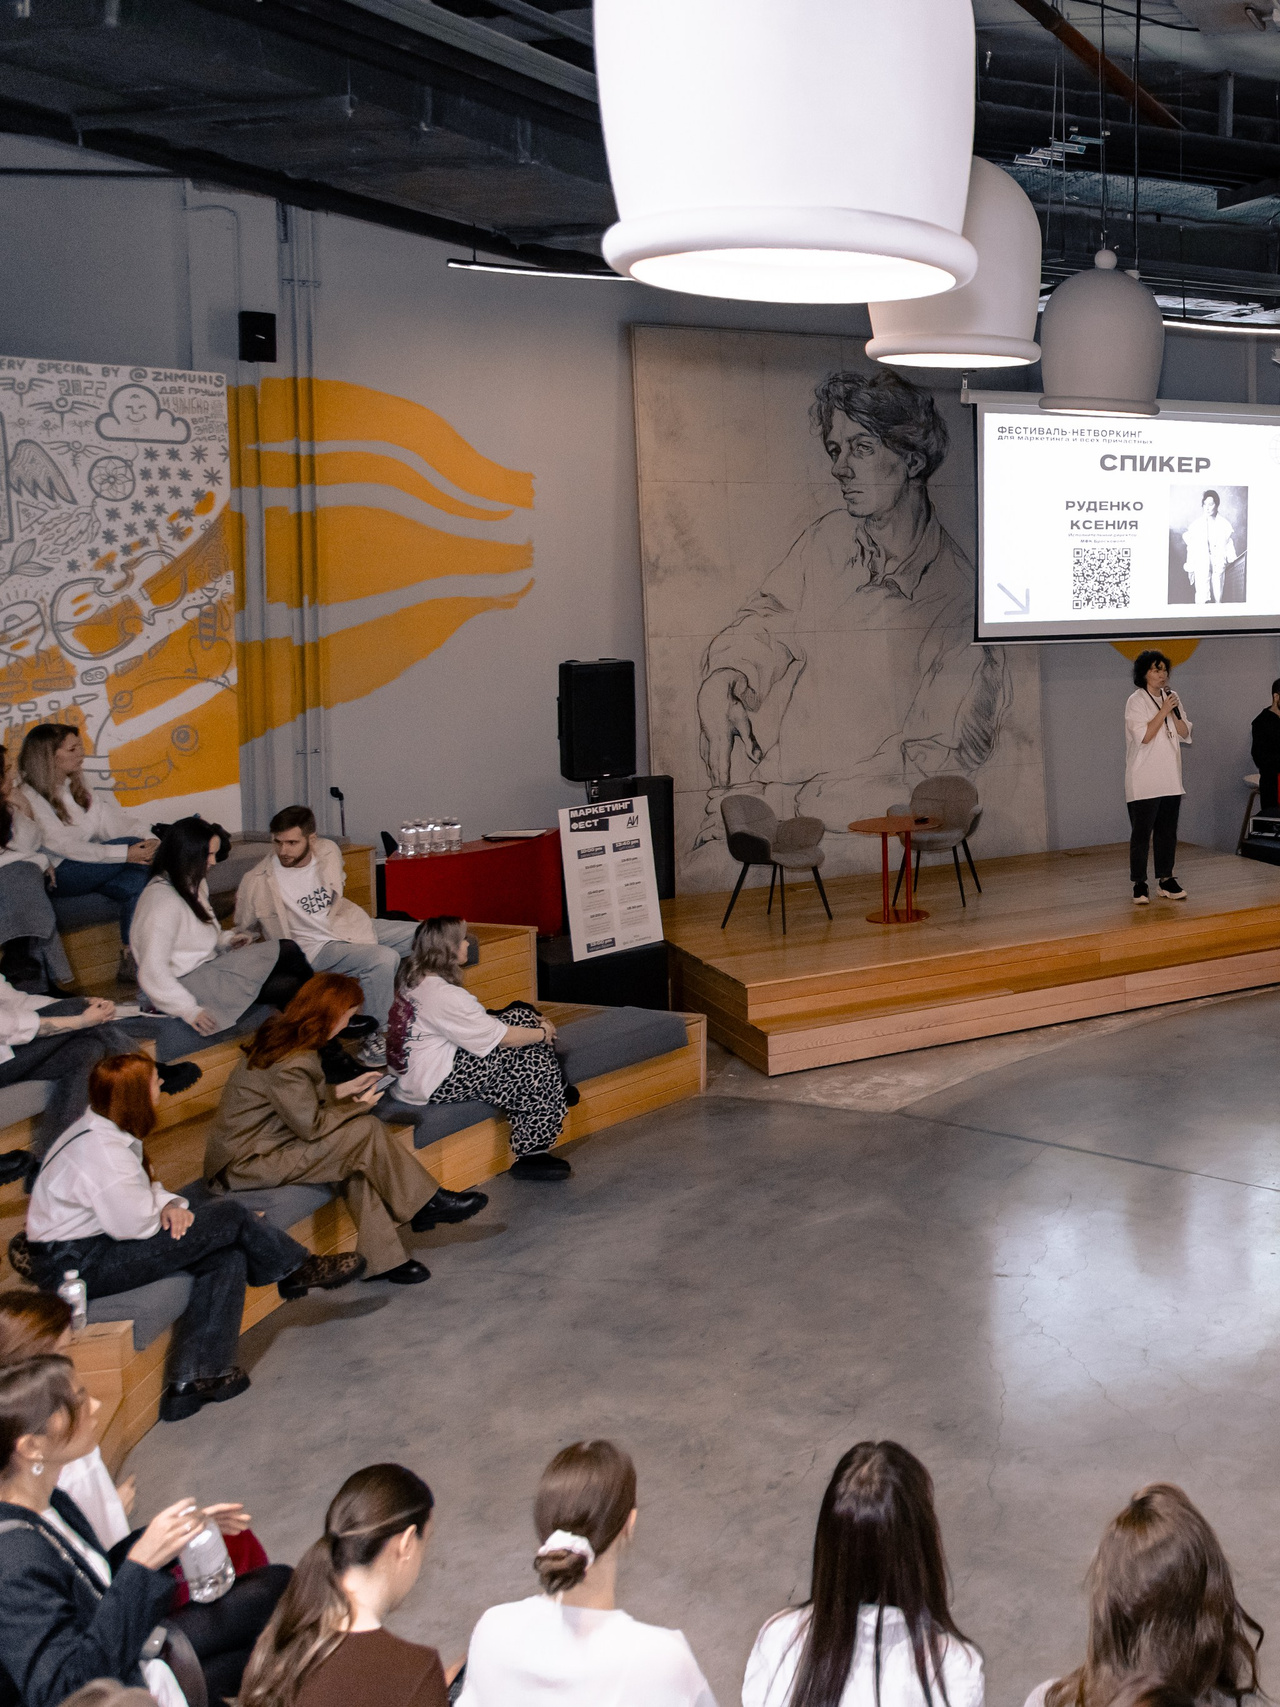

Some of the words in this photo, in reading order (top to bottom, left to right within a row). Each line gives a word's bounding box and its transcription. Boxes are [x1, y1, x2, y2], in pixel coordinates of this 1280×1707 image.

[37, 362, 92, 376] SPECIAL
[101, 366, 120, 378] BY
[159, 386, 185, 395] ДВЕ
[188, 387, 225, 397] ГРУШИ
[1100, 454, 1211, 473] СПИКЕР
[1065, 500, 1144, 513] РУДЕНКО
[1070, 520, 1138, 530] КСЕНИЯ
[570, 801, 631, 818] МАРКЕТИНГ
[571, 819, 600, 830] ФЕСТ
